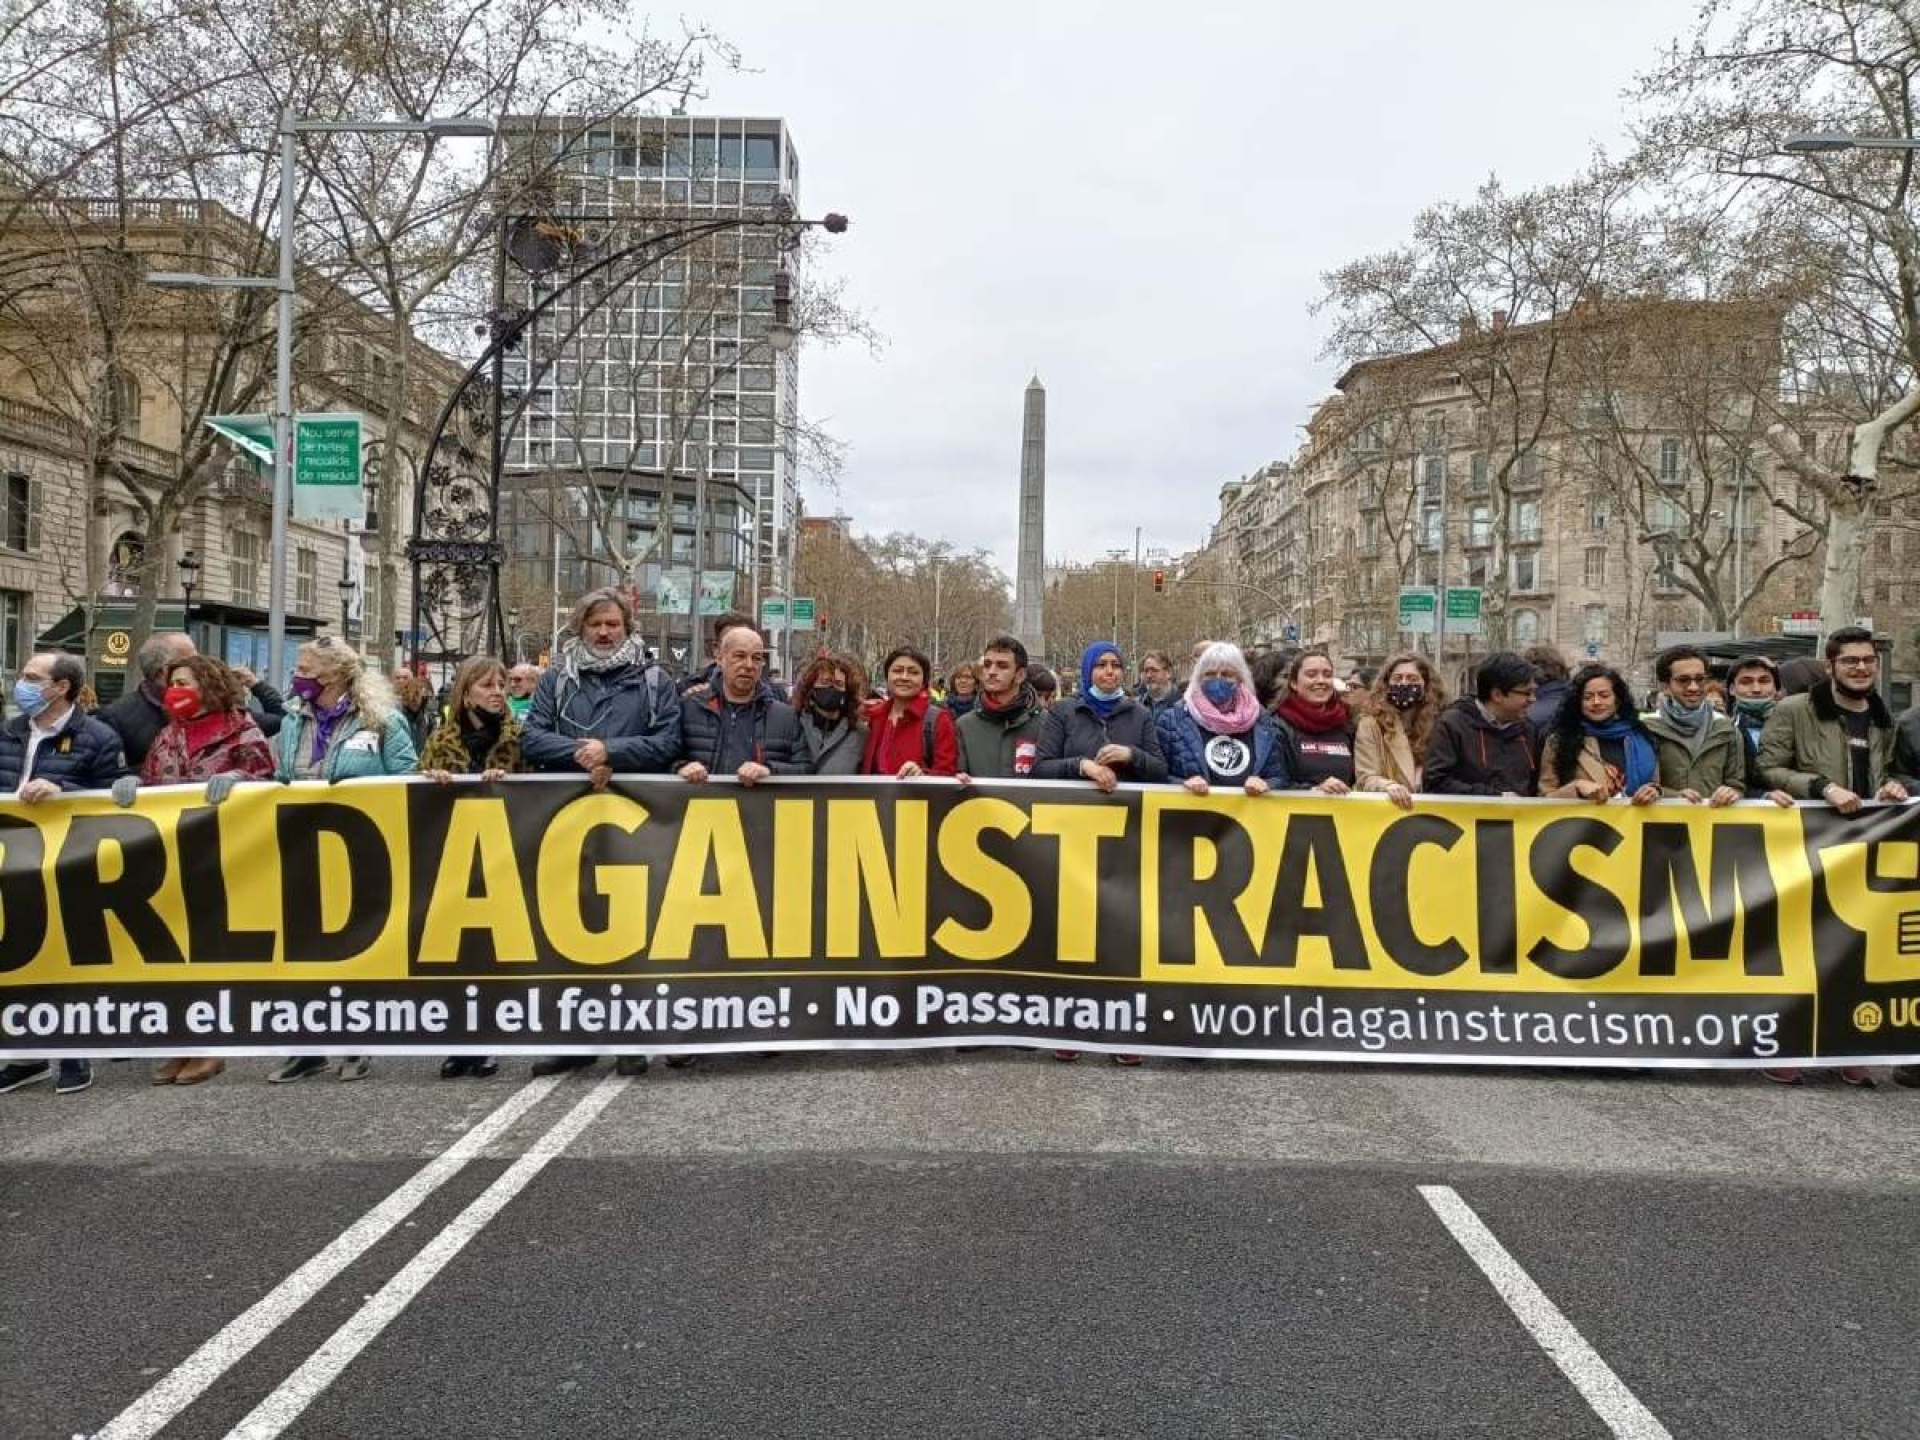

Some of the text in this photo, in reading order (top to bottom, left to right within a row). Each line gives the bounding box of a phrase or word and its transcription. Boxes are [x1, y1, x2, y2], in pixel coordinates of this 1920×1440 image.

[417, 793, 1127, 965] AGAINST
[1158, 808, 1784, 979] RACISM
[3, 984, 1780, 1055] contra el racisme i el feixisme! No Passaran! worldagainstracism.org
